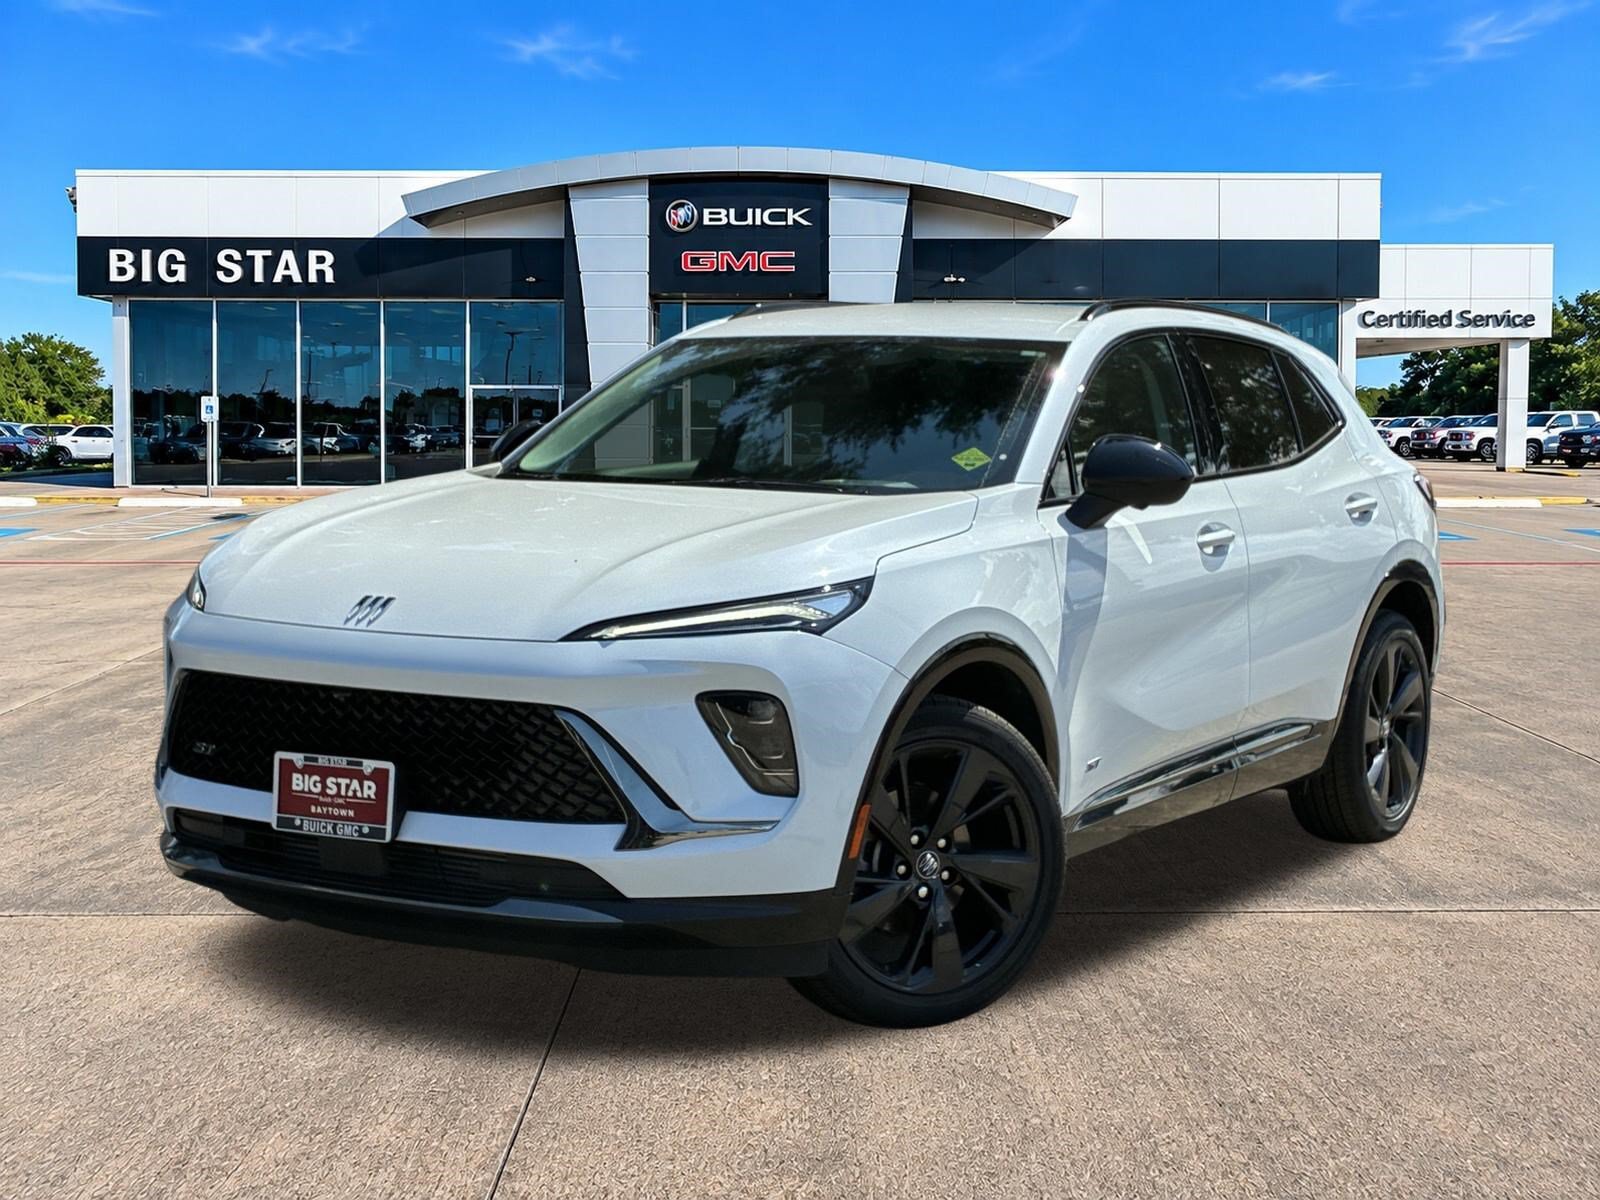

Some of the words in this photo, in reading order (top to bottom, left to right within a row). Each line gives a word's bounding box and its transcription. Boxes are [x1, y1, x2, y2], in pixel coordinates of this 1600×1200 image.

[702, 207, 813, 226] BUICK
[108, 248, 187, 283] BIG
[215, 249, 336, 284] STAR
[681, 251, 796, 272] GMC
[1359, 310, 1453, 329] Certified
[1455, 309, 1536, 329] Service
[291, 772, 322, 794] BIG
[325, 776, 377, 799] STAR
[310, 805, 355, 817] BAYTOWN
[302, 819, 334, 834] BUICK
[336, 823, 360, 837] GMC
